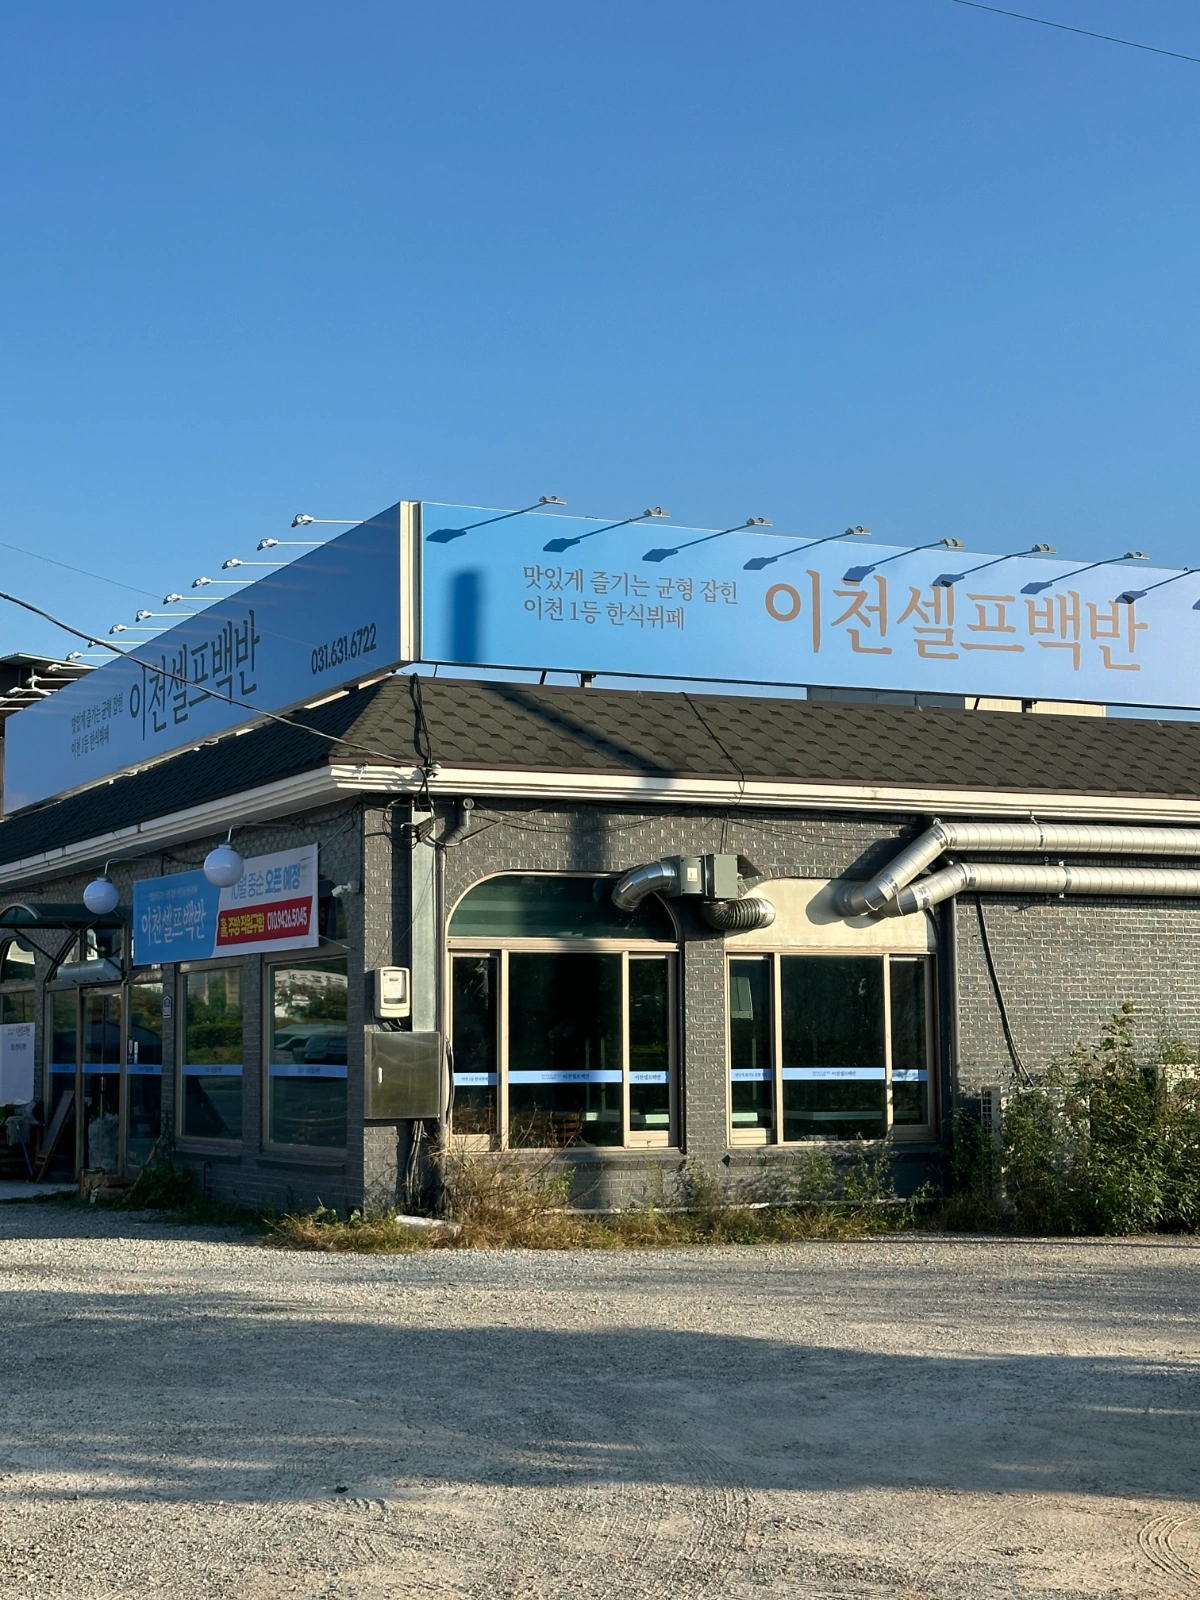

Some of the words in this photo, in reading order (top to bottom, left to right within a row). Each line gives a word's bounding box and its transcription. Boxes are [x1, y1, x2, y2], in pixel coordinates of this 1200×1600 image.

[523, 564, 584, 593] 맛있게
[589, 570, 651, 597] 즐기는
[655, 576, 694, 602] 균형
[699, 578, 738, 605] 잡힌
[523, 595, 564, 622] 이천
[569, 600, 601, 625] 1등
[605, 601, 685, 631] 한식뷔페
[765, 568, 1148, 671] 이천셀프백반
[310, 622, 378, 676] 031.631.6722
[129, 609, 261, 741] 이천셀프백반
[248, 871, 264, 897] 중순
[265, 866, 282, 894] 오픈
[283, 863, 301, 891] 예정
[141, 898, 206, 946] 이천셀프백반
